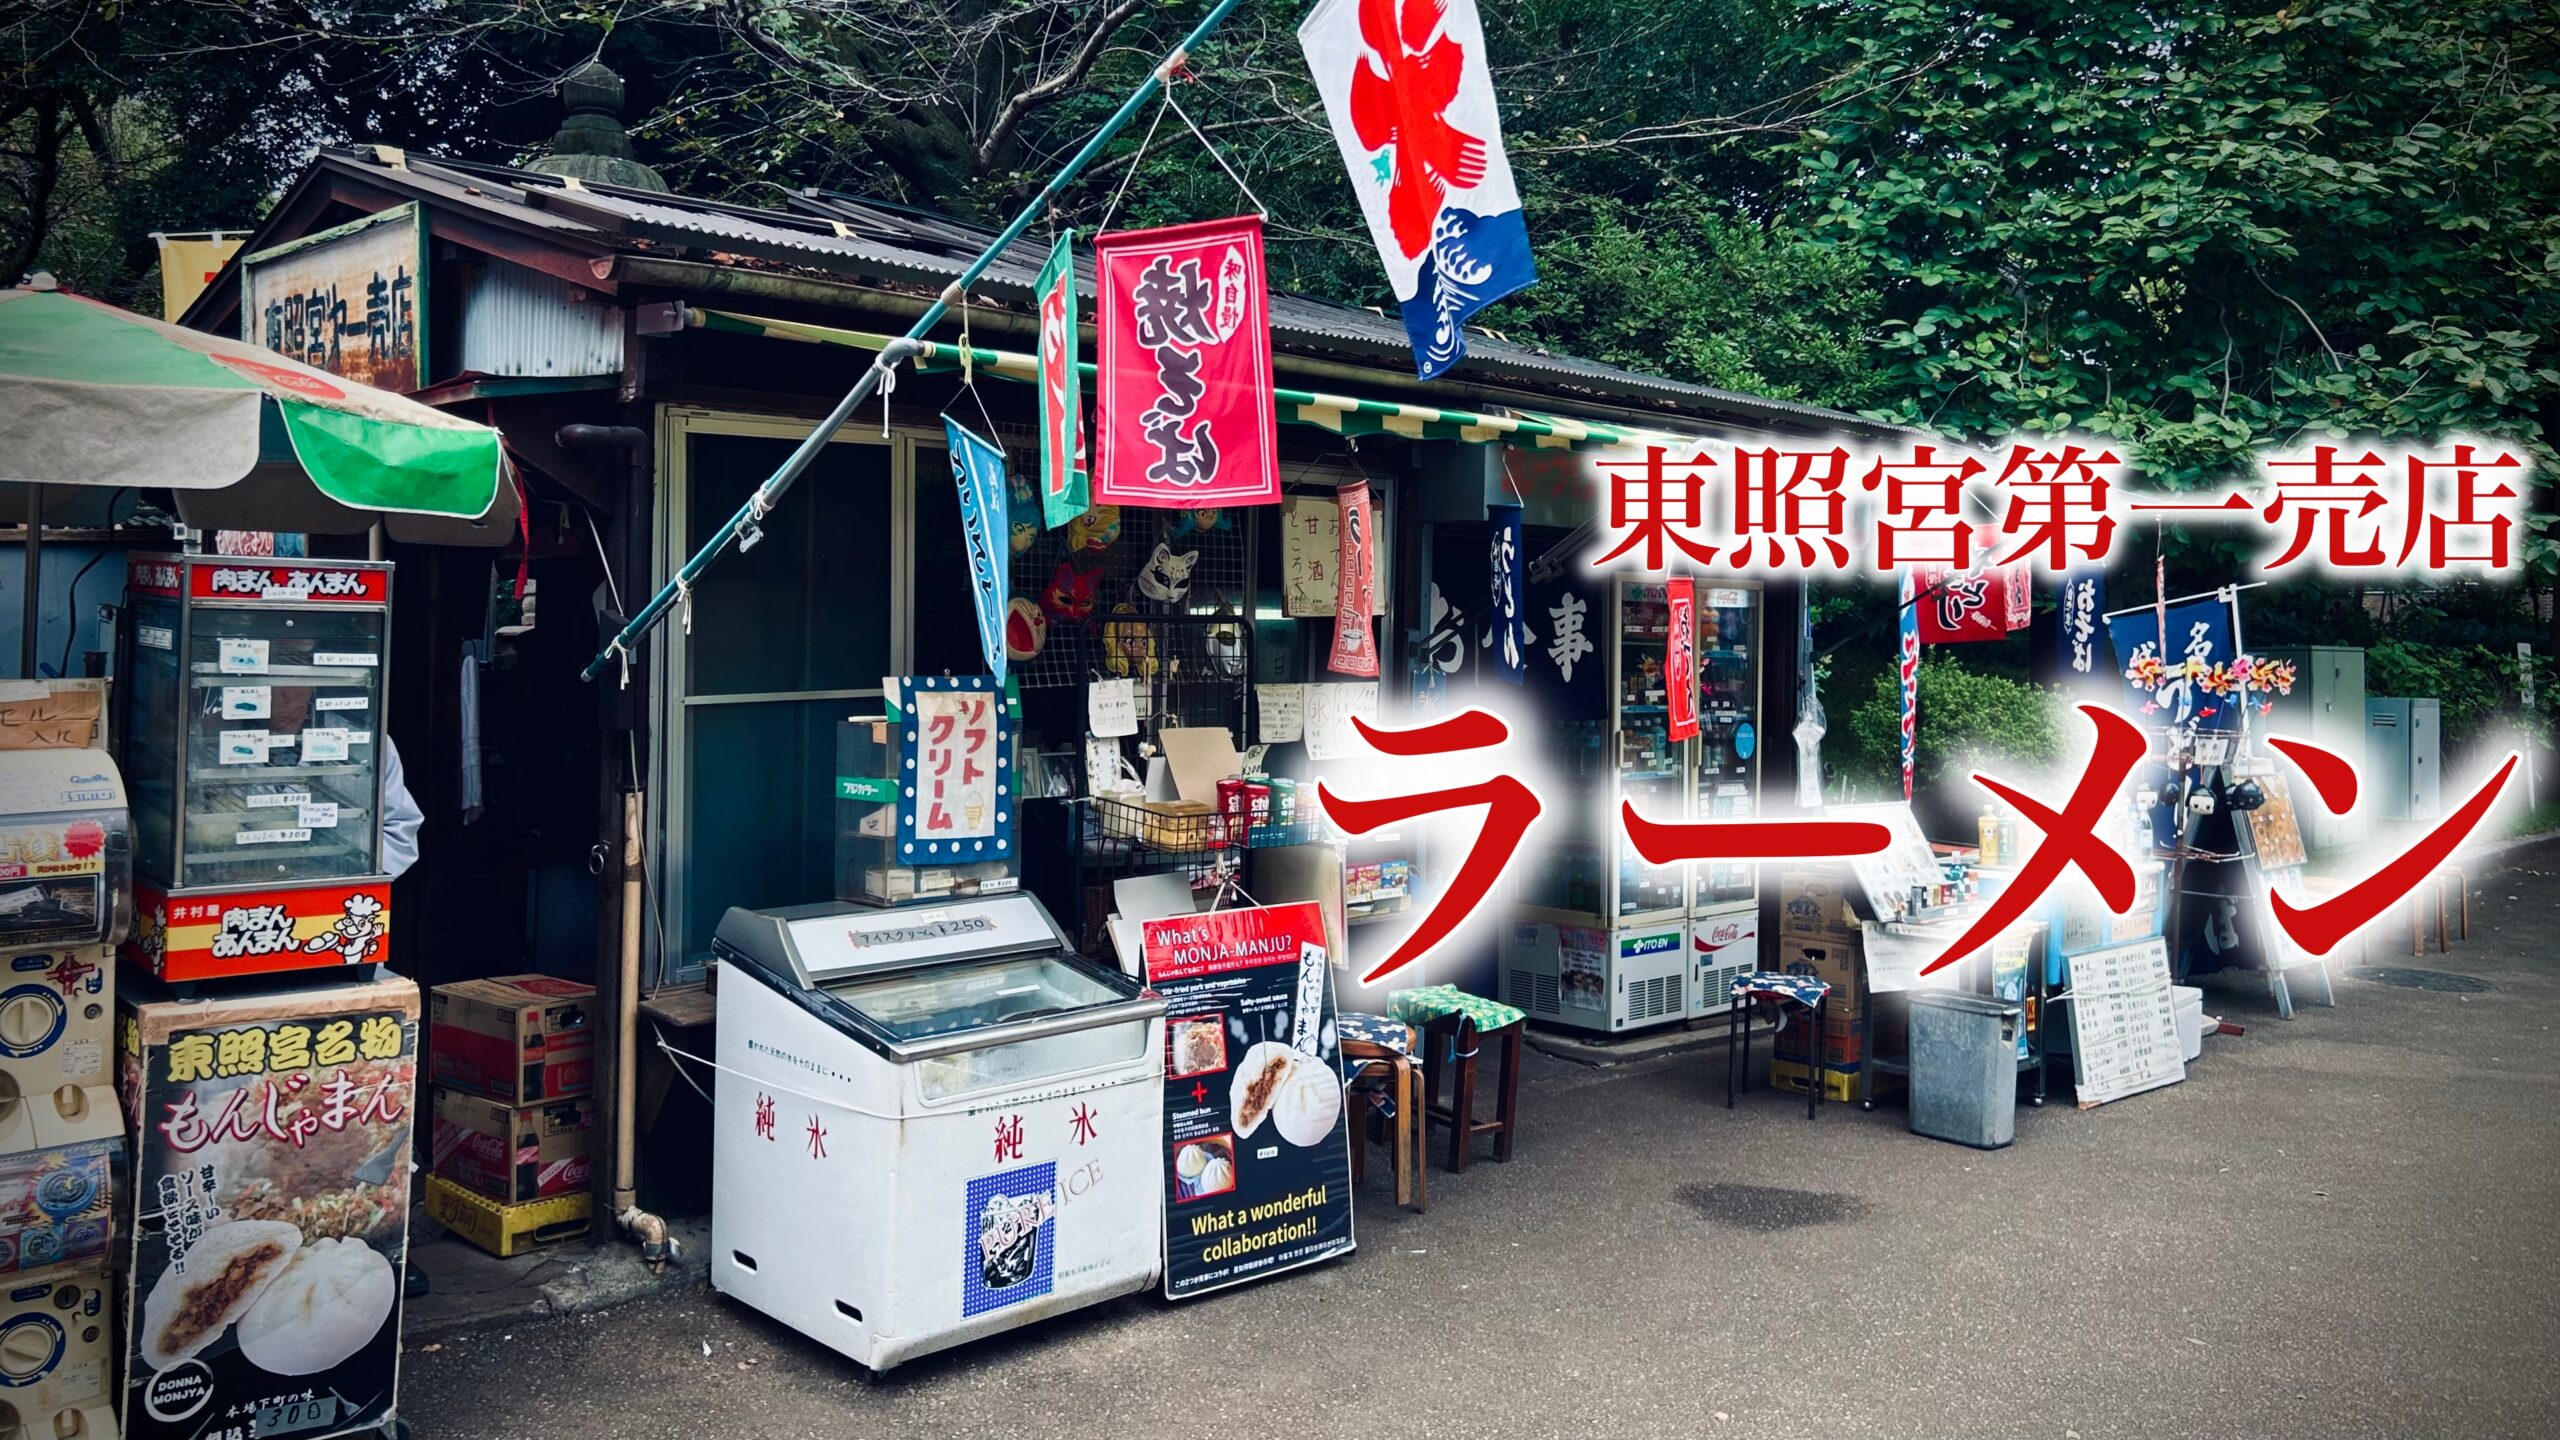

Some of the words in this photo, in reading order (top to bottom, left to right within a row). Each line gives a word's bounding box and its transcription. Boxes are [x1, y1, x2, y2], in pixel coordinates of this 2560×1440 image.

[1305, 515, 1324, 582] 甘酒
[959, 700, 986, 785] ソフト
[927, 716, 955, 831] クリーム
[843, 782, 879, 796] フジカラー
[172, 903, 221, 920] 井村屋
[221, 904, 295, 931] 肉まん
[938, 919, 985, 936] ¥250
[1156, 926, 1209, 947] What's
[211, 929, 301, 959] あんまん
[1173, 934, 1293, 966] MONJA-MANJU?
[1644, 939, 1657, 951] ITO
[1658, 937, 1669, 949] EN
[166, 1015, 403, 1083] 東照宮名物
[159, 1068, 404, 1154] もんじゃまん
[1058, 1157, 1104, 1206] ICE
[1191, 1209, 1234, 1237] What
[1237, 1209, 1248, 1226] a
[1250, 1184, 1327, 1223] wonderful
[1202, 1216, 1318, 1263] collaboration!!
[153, 1386, 205, 1406] MONJYA
[158, 1374, 202, 1393] DONNA
[267, 1400, 321, 1429] 300
